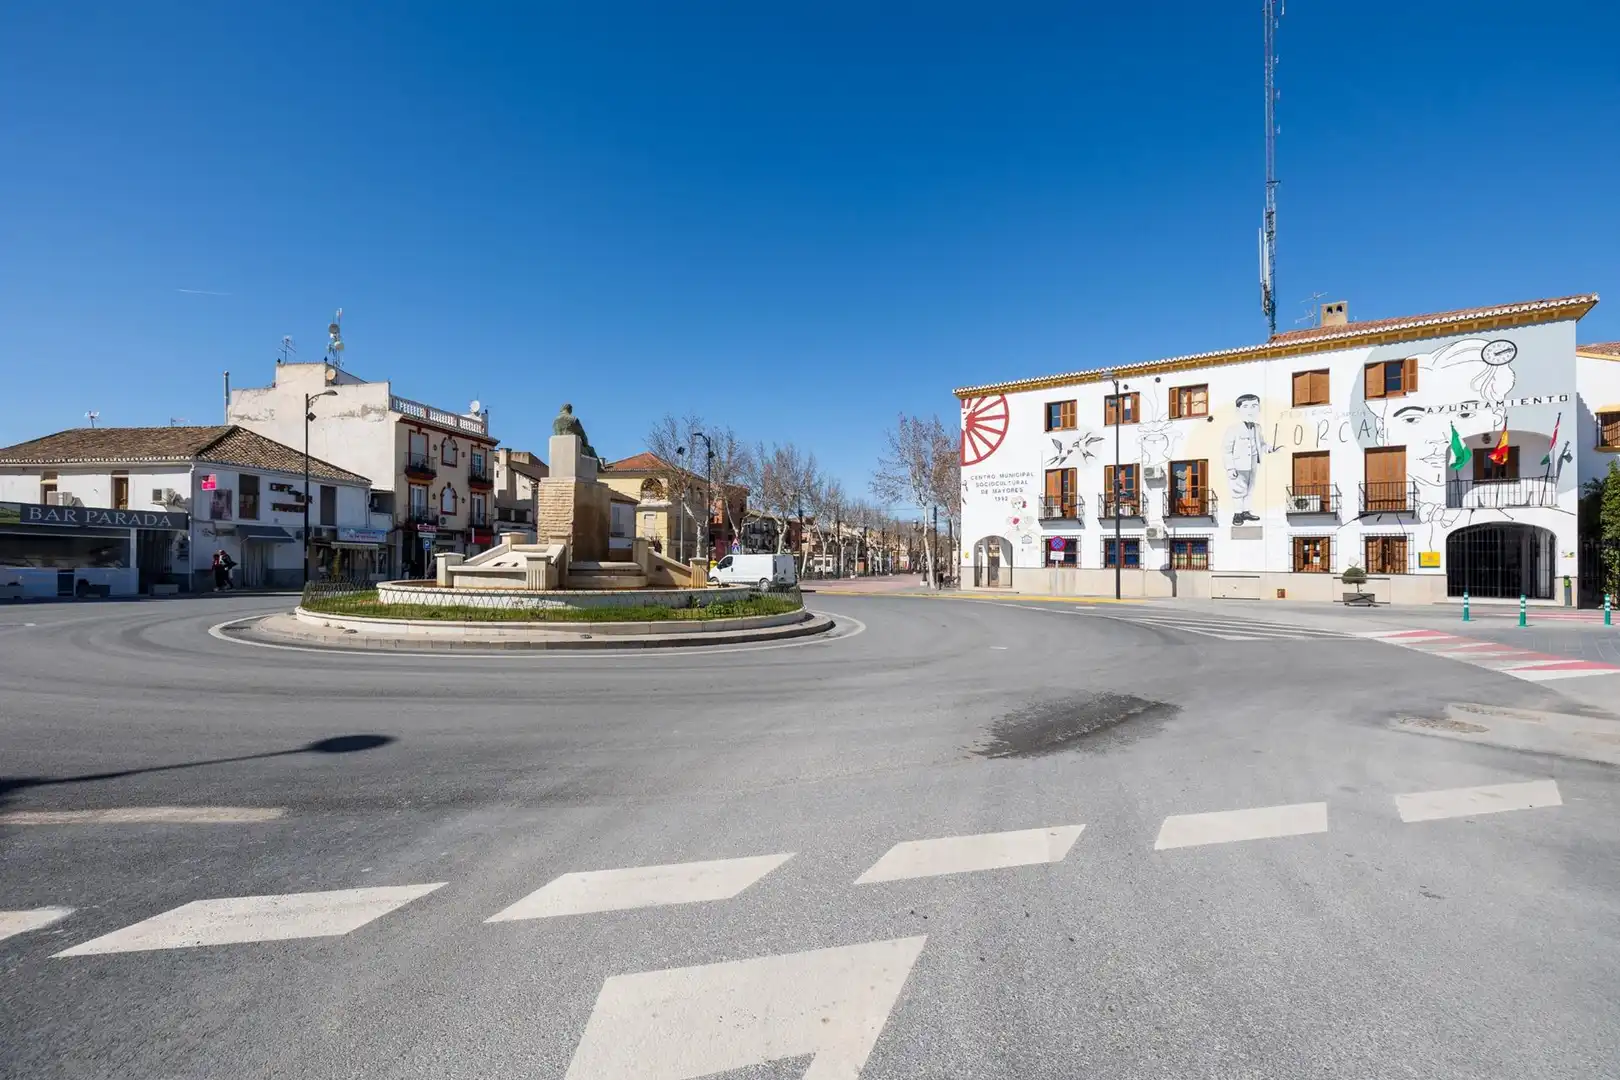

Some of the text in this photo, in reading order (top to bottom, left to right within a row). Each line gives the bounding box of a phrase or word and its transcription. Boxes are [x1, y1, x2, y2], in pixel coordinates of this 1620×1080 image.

[1427, 394, 1568, 414] AYUNTAMIENTO
[1272, 418, 1372, 451] LORCA
[29, 507, 172, 527] BAR PARADA
